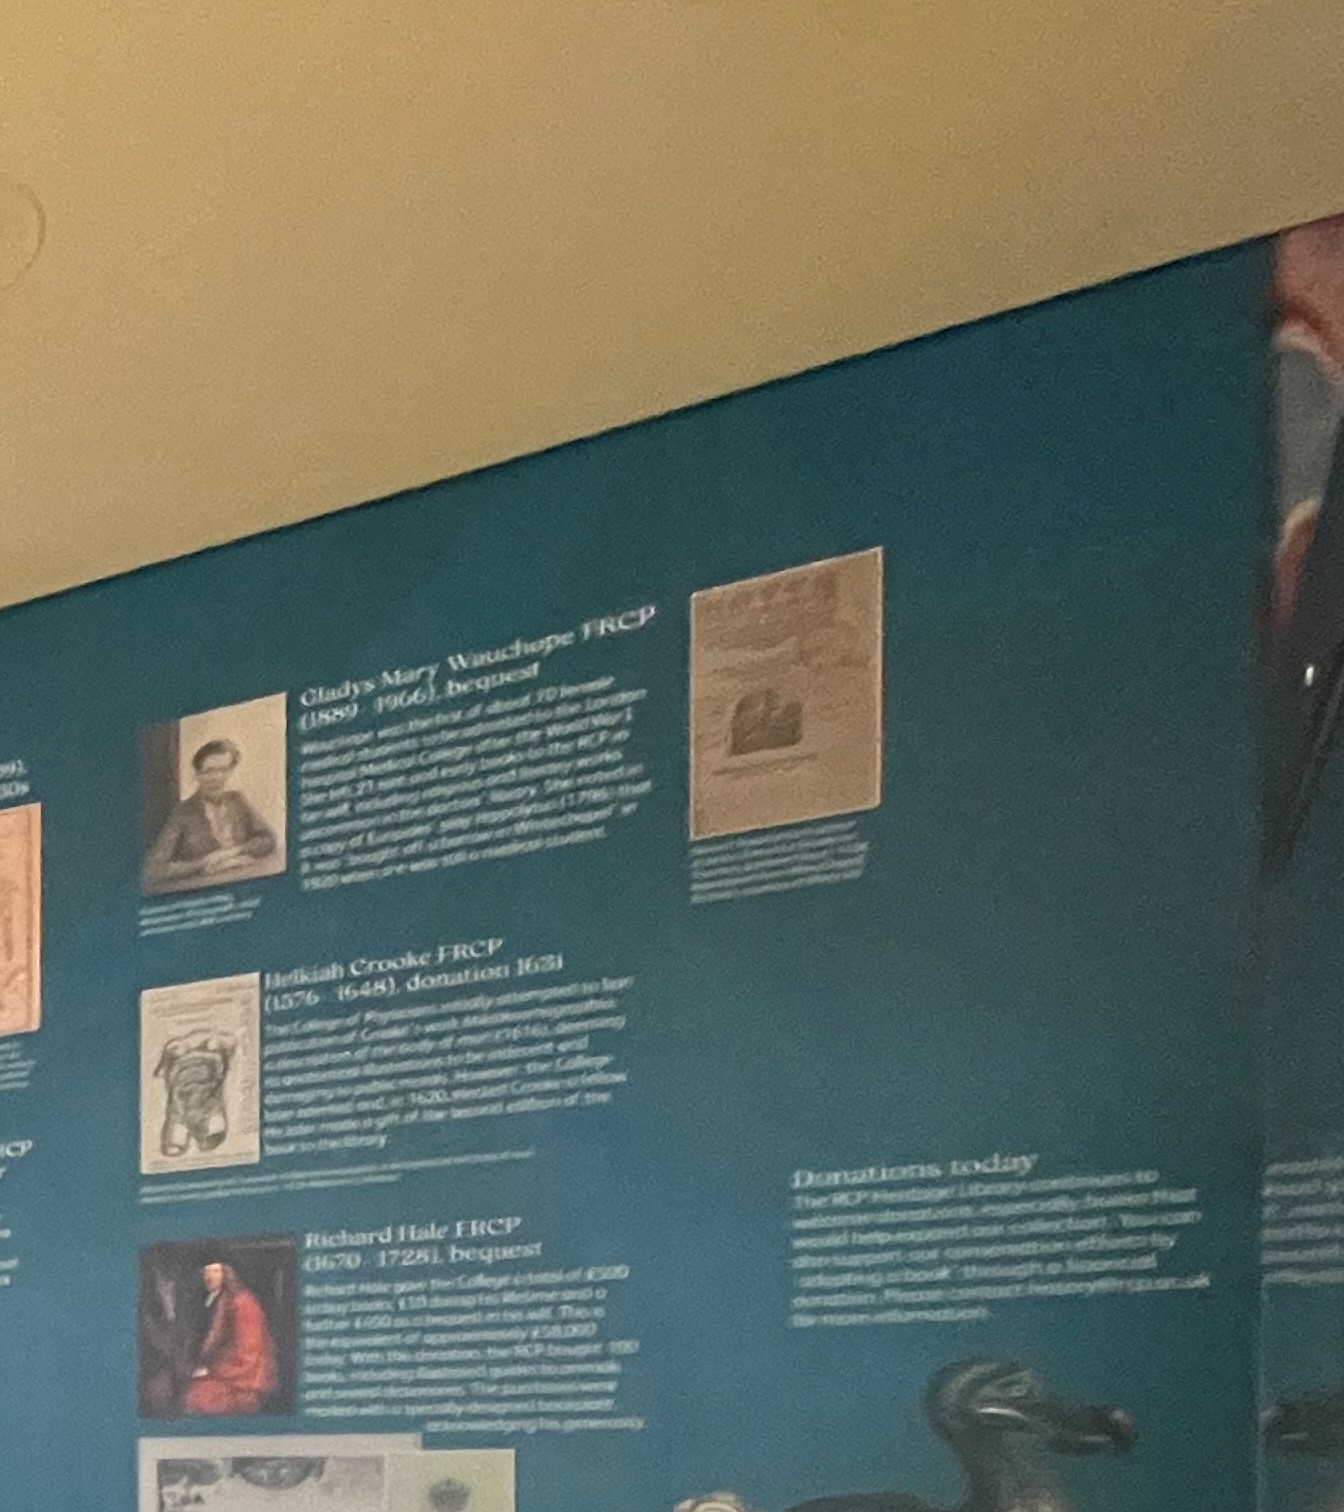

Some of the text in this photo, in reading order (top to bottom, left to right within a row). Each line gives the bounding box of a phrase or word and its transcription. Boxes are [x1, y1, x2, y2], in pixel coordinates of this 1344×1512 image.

[300, 604, 657, 707] Gladys Mary Wauchope FRCP
[446, 661, 541, 698] bequest
[349, 950, 432, 976] Crooke
[438, 937, 504, 964] FRCP
[406, 963, 510, 992] donation
[791, 1151, 1040, 1191] Donations today
[304, 1216, 522, 1248] Richard Hale FRCP
[377, 1246, 444, 1268] 1728),
[449, 1241, 543, 1264] bequest
